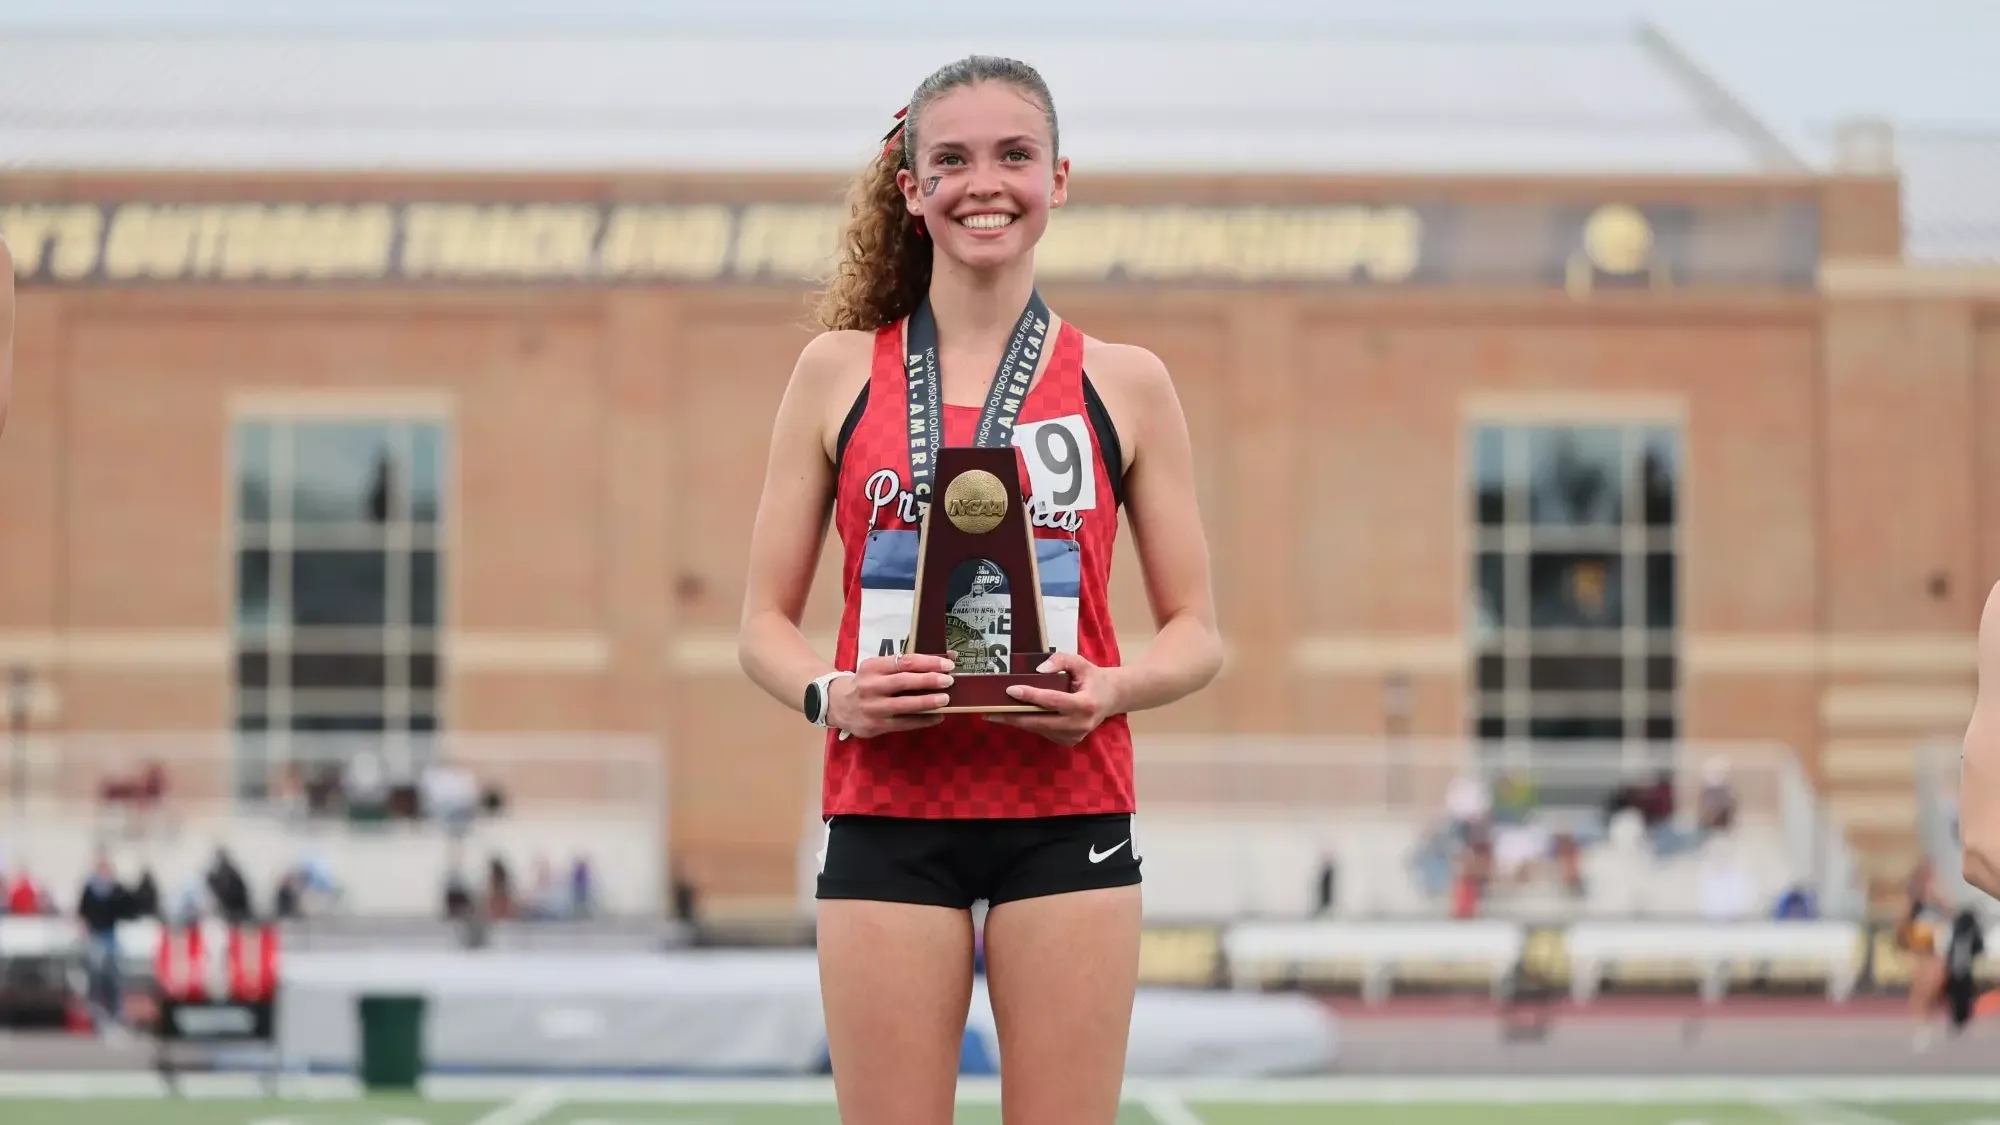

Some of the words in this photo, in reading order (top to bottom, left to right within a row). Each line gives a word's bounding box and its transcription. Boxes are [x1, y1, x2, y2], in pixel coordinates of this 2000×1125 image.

[1017, 332, 1024, 340] &
[1020, 310, 1034, 334] FIELD
[926, 347, 935, 372] NCAA
[1006, 338, 1023, 363] TRACK
[927, 372, 938, 409] DIVISION
[990, 363, 1012, 407] OUTDOOR
[998, 317, 1047, 447] -AMERICAN
[909, 354, 932, 517] ALL-AMERICA
[977, 415, 994, 448] IVISION
[1034, 422, 1083, 506] 9
[950, 499, 1005, 517] NCAA
